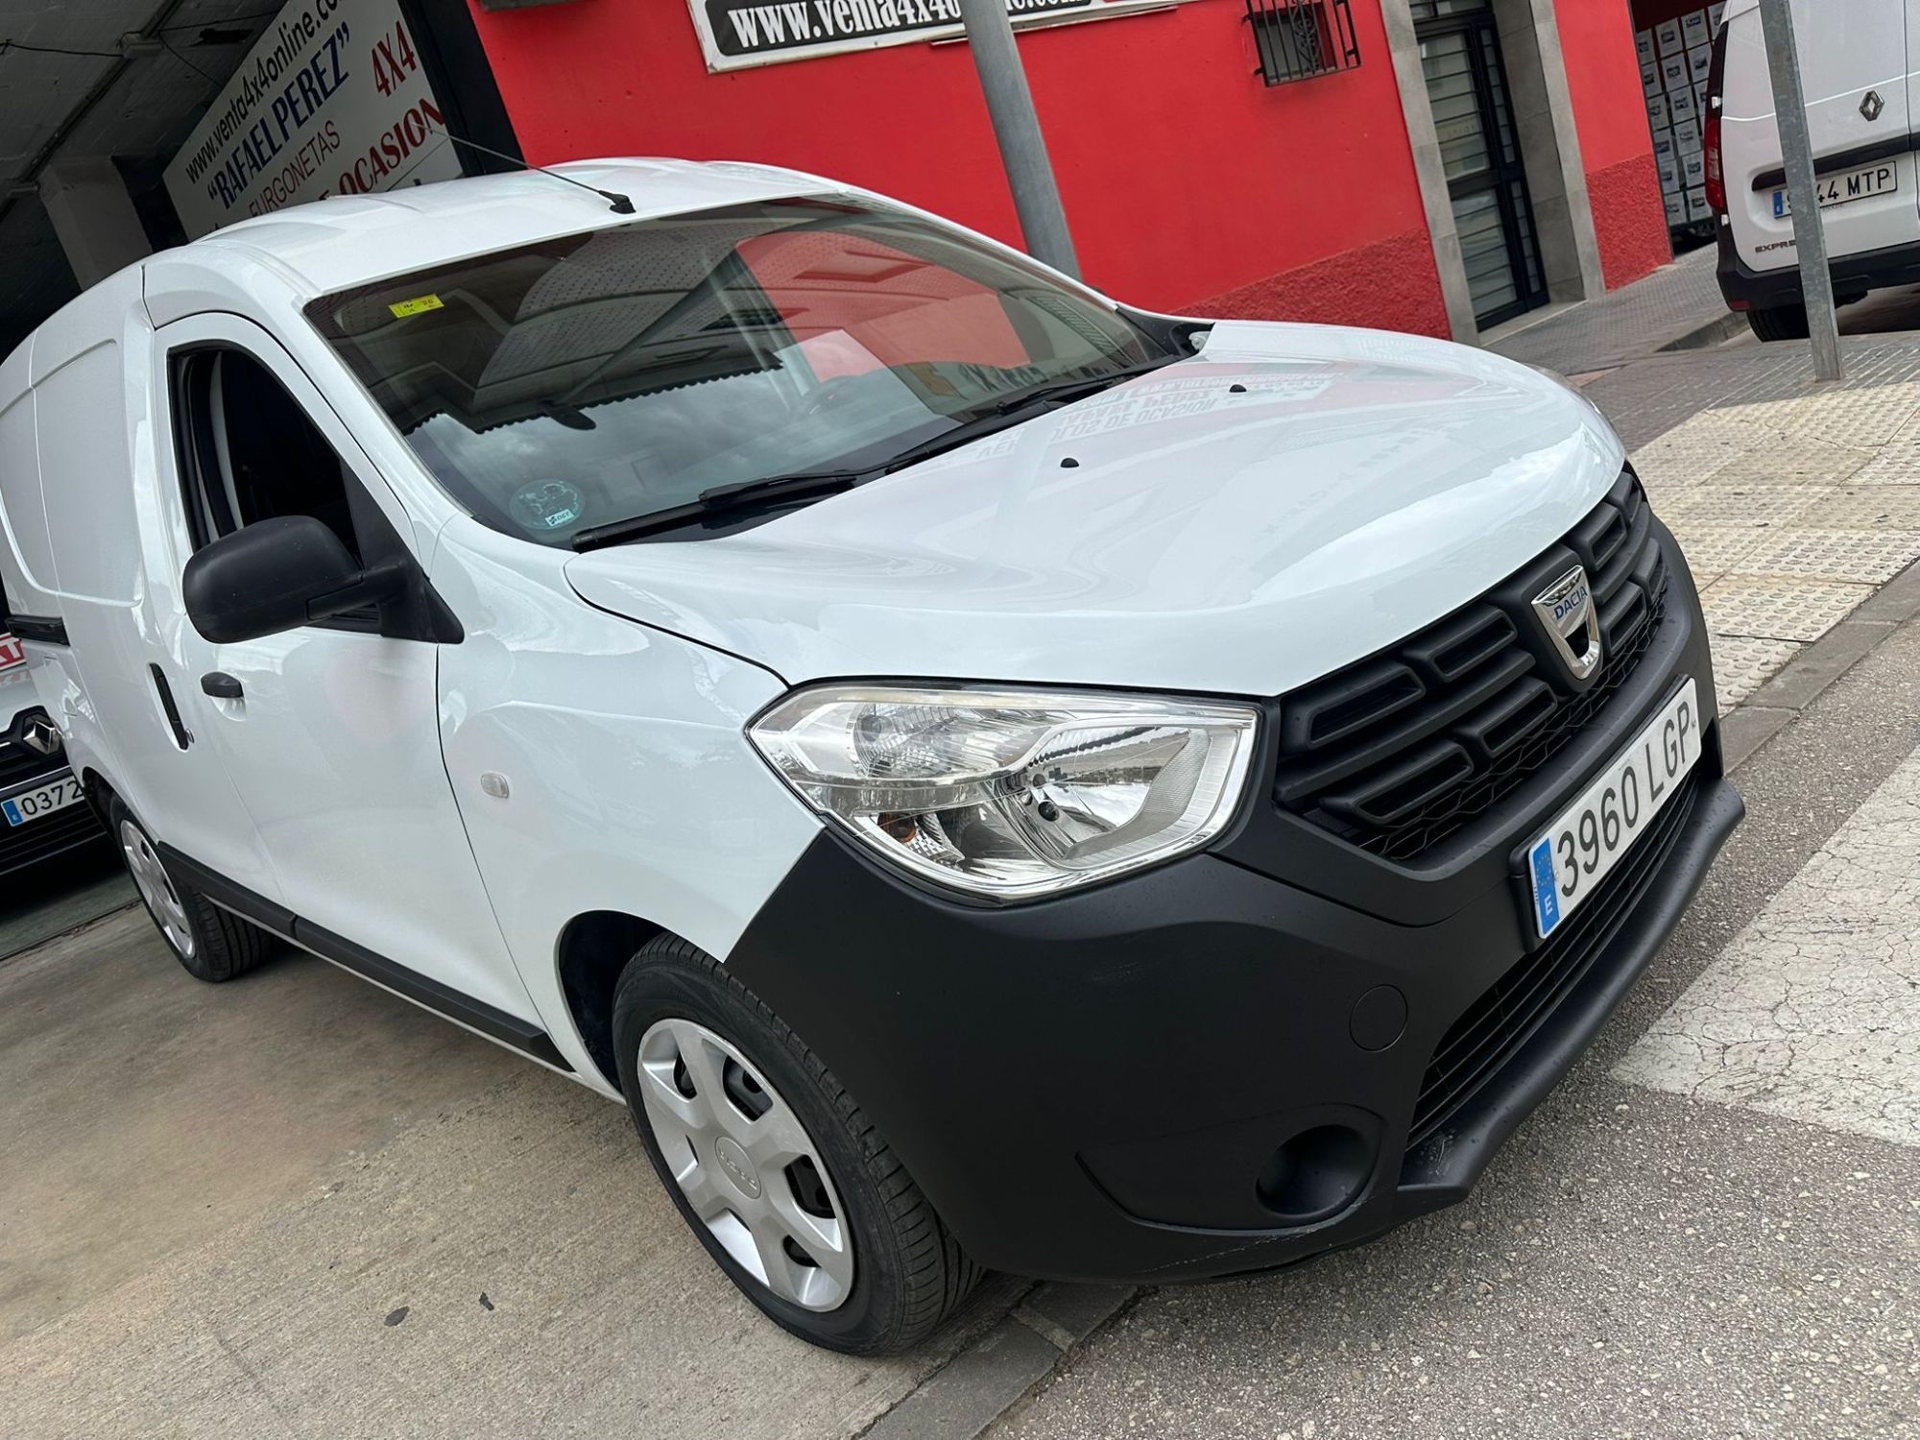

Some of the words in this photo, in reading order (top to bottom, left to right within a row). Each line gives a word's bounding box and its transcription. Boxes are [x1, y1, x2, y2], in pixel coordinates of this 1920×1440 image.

[186, 0, 339, 184] www.venta4x4online.c
[1847, 168, 1890, 197] MTP
[1755, 239, 1797, 254] EXPRE
[1554, 584, 1589, 621] DACIA
[21, 779, 83, 816] 0372
[1556, 764, 1640, 899] 3960
[1644, 700, 1691, 804] LGP
[1544, 895, 1555, 917] E
